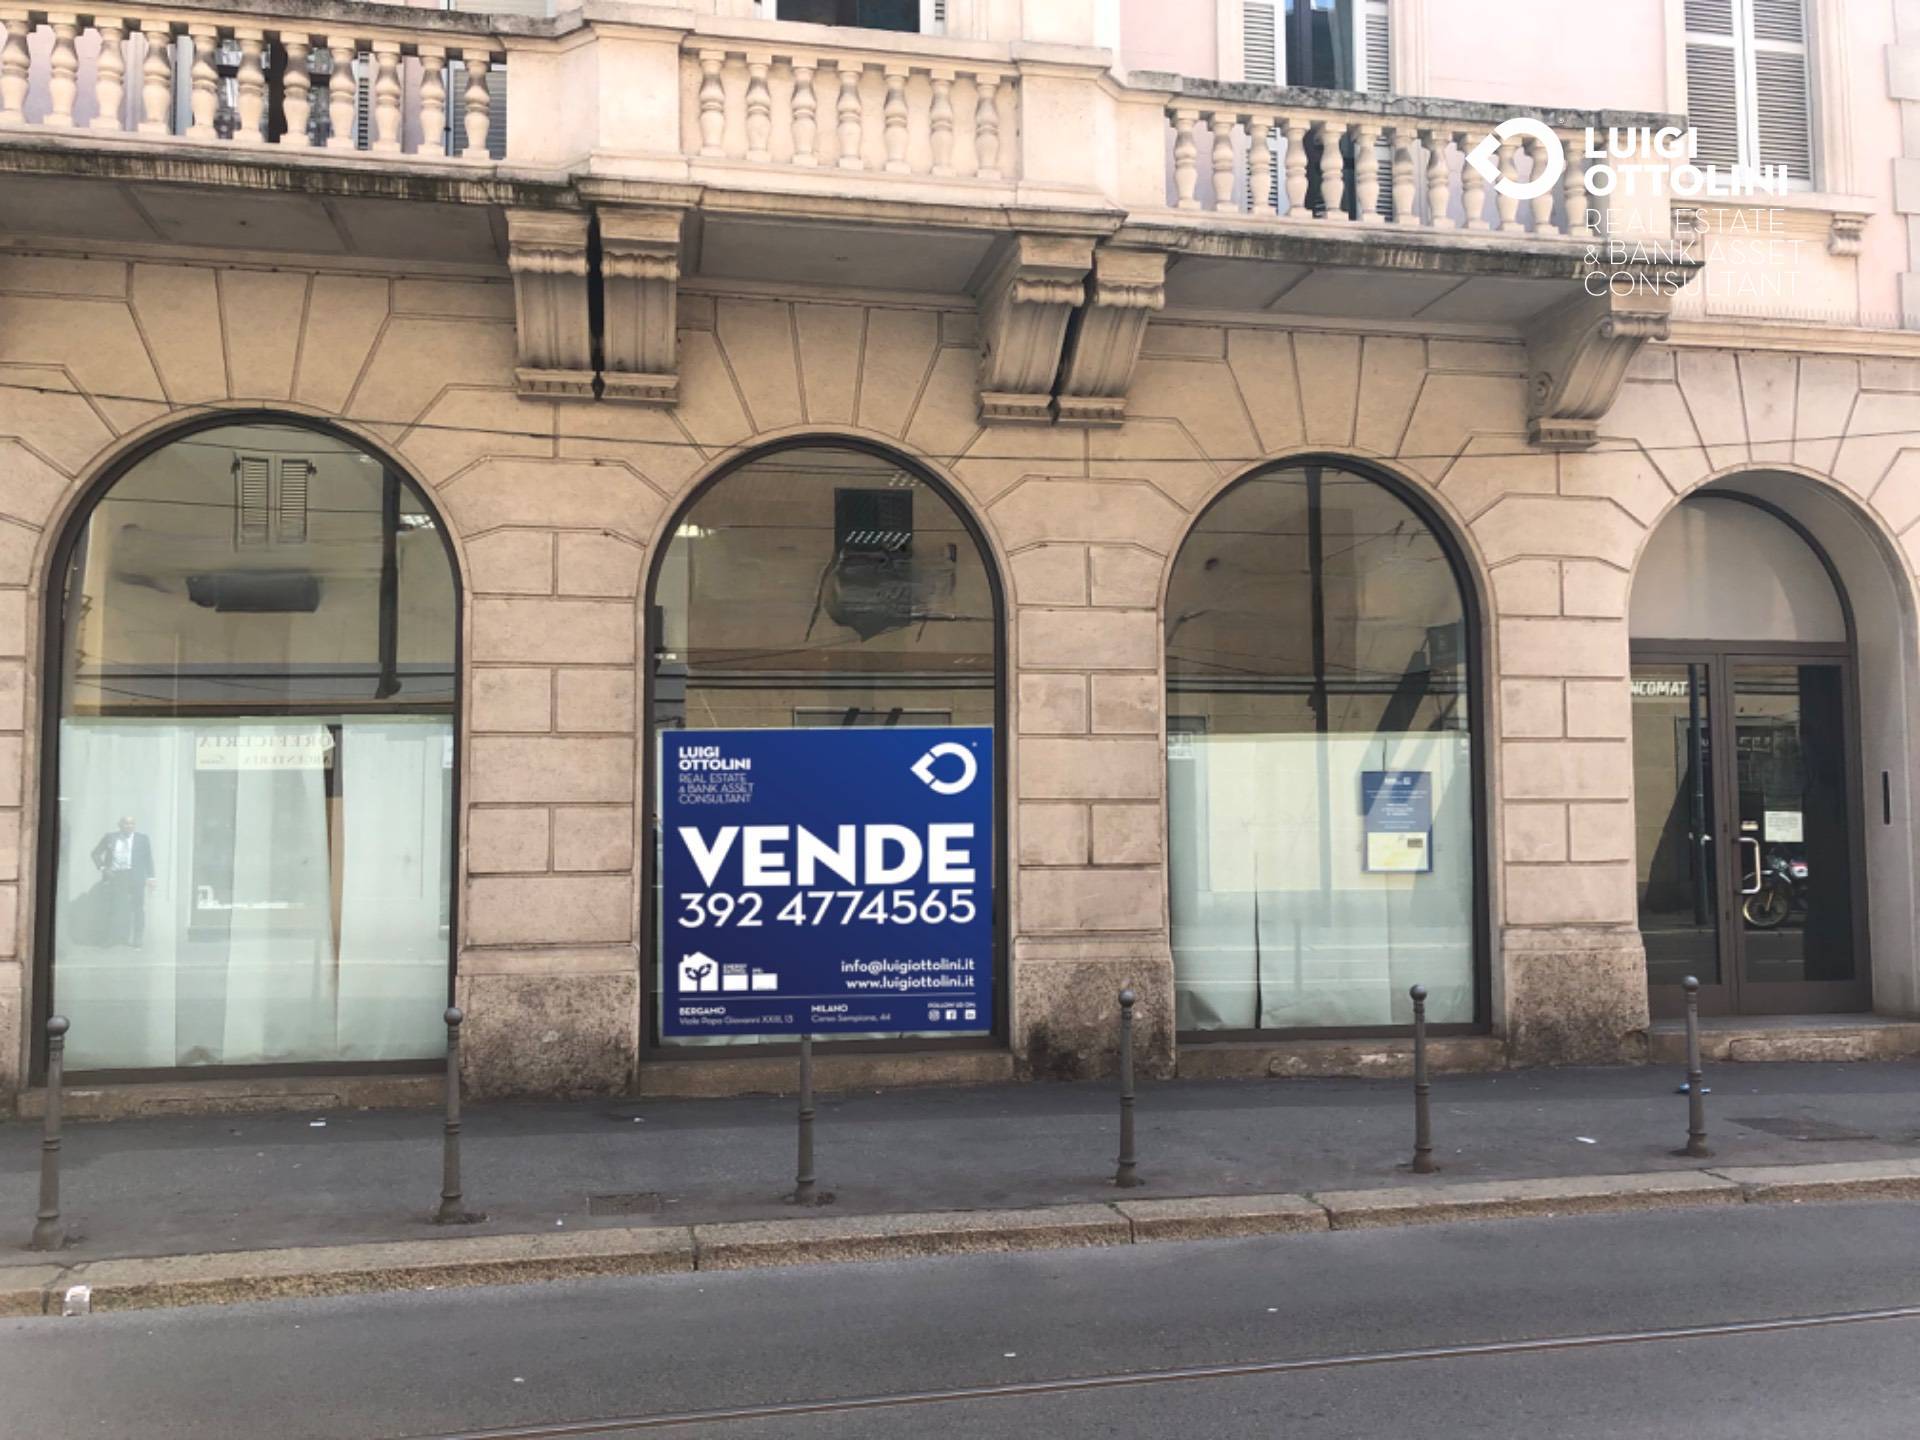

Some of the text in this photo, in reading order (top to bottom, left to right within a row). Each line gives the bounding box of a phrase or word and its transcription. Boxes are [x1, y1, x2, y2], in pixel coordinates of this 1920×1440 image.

[1631, 681, 1688, 697] NCOMAT
[679, 746, 720, 759] LUIGI
[679, 758, 752, 771] OTTOLINI
[679, 772, 747, 784] REAL ESTATE
[687, 783, 718, 794] BANK
[721, 782, 755, 794] ASSET
[679, 793, 753, 805] CONSULTANT
[677, 822, 977, 888] VENDE
[677, 888, 977, 928] 392 4774565
[840, 957, 976, 976] info@luigiottolini.it
[845, 974, 976, 992] www.luigiottolini.it
[679, 1006, 727, 1016] BERGAMO
[810, 1003, 849, 1014] MILANO
